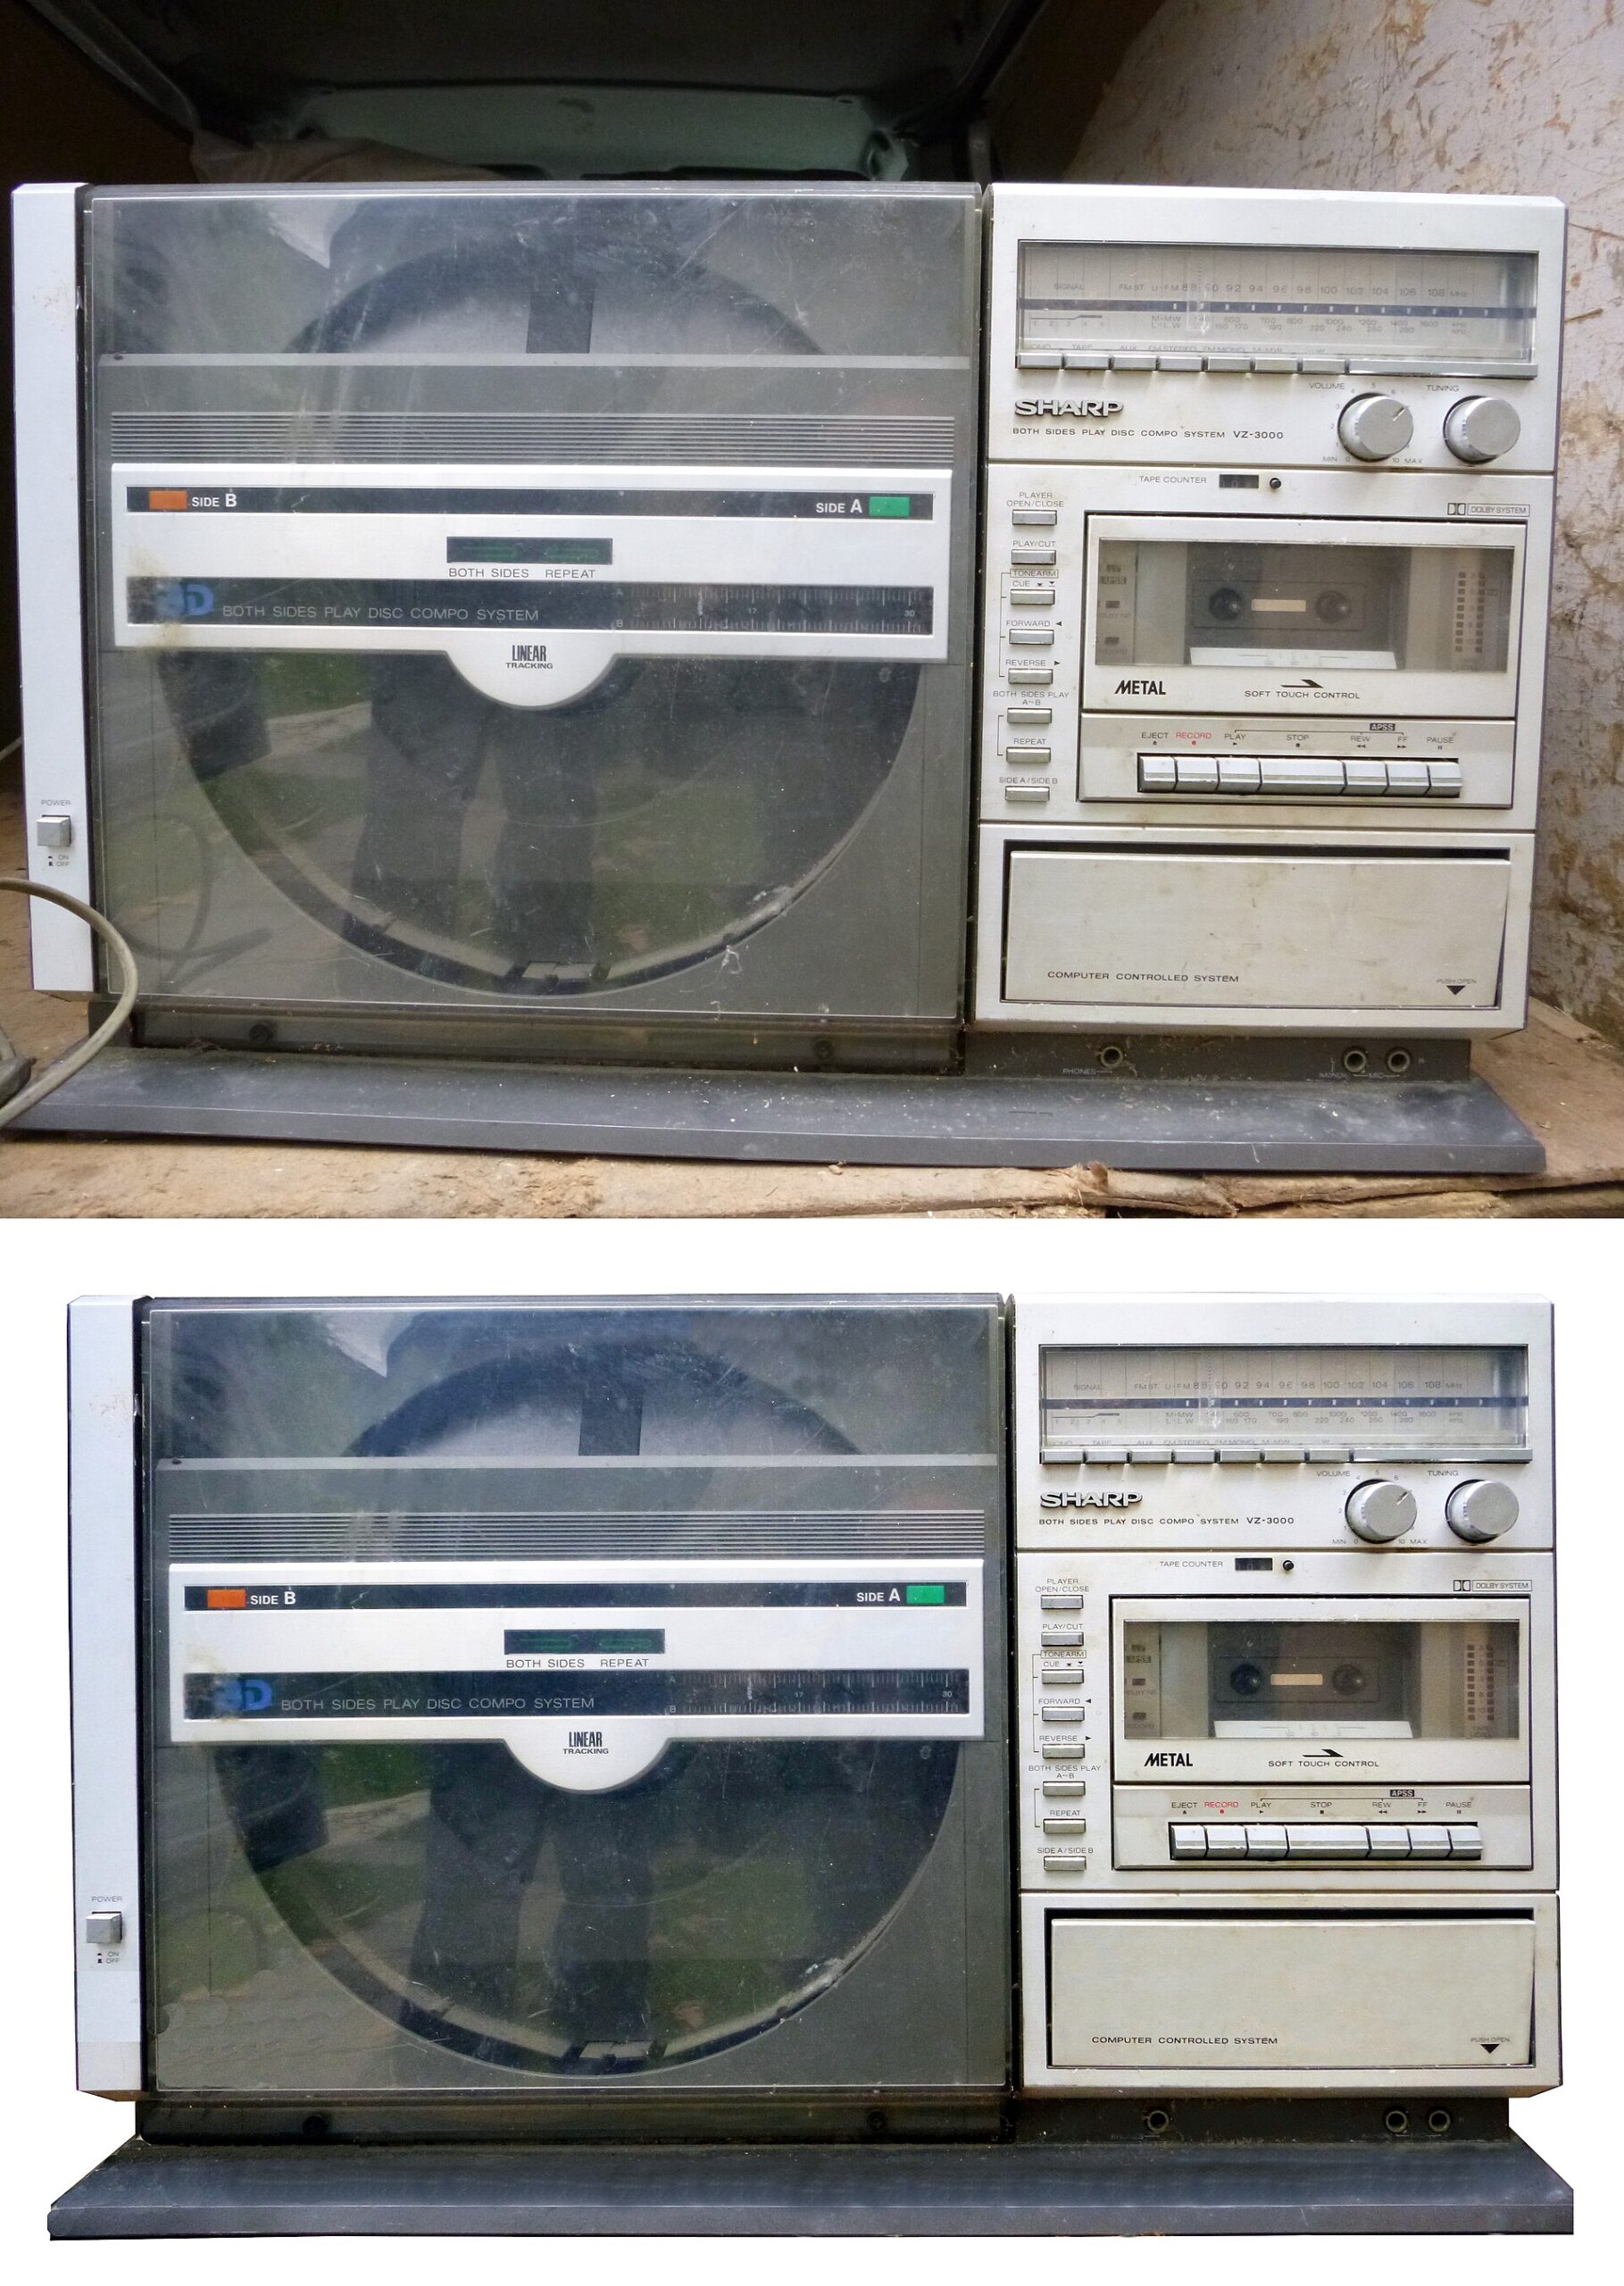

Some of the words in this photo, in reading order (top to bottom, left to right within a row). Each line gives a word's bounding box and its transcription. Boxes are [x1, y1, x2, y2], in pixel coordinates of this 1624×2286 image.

[1226, 284, 1241, 293] 92
[1249, 284, 1263, 293] 94
[1297, 286, 1312, 295] 98
[1320, 286, 1337, 295] 100
[1346, 287, 1363, 296] 102
[1372, 288, 1388, 296] 104
[1399, 288, 1417, 296] 106
[1428, 288, 1445, 297] 108
[1309, 381, 1346, 390] VOLUME
[1427, 384, 1460, 392] TUNING
[1013, 398, 1125, 419] SHARP
[1012, 427, 1040, 436] BOTH
[1045, 428, 1077, 436] SIDES
[1081, 429, 1106, 437] PLAY
[1111, 429, 1136, 438] DISC
[1140, 430, 1178, 438] COMPO
[1184, 430, 1226, 438] SYSTEM
[1233, 430, 1284, 440] VZ-3000
[1139, 475, 1162, 484] TAPE
[1163, 476, 1207, 484] COUNTER
[191, 496, 220, 508] SIDE
[225, 493, 237, 508] B
[1006, 500, 1064, 508] OPEN/CLOSE
[815, 502, 845, 513] SIDE
[849, 498, 862, 513] A
[1470, 505, 1495, 514] DOLBY
[1495, 505, 1527, 514] SYSTEM
[448, 568, 485, 578] BOTH
[490, 568, 529, 579] SIDES
[545, 569, 595, 579] REPEAT
[223, 605, 265, 617] BOTH
[273, 605, 317, 618] SIDES
[324, 606, 362, 618] PLAY
[368, 607, 403, 620] DISC
[410, 608, 469, 620] COMPO
[477, 609, 539, 622] SYSTEM
[904, 610, 915, 618] 30
[1005, 620, 1051, 628] FORWARD
[512, 645, 547, 662] LINEAR
[505, 662, 554, 670] TRACKING
[1005, 659, 1046, 667] REVERSE
[1114, 680, 1167, 696] METAL
[1020, 690, 1045, 698] SIDES
[1245, 690, 1270, 698] SOFT
[1276, 690, 1309, 699] TOUCH
[1313, 691, 1361, 699] CONTROL
[1370, 723, 1395, 731] APSS
[1141, 731, 1169, 739] EJECT
[1176, 731, 1212, 739] RECORD
[1286, 734, 1310, 742] STOP
[1013, 738, 1046, 746] REPEAT
[1427, 736, 1454, 744] PAUSE
[1047, 971, 1110, 980] COMPUTER
[1115, 972, 1189, 982] CONTROLLED
[1194, 974, 1239, 983] SYSTEM
[1235, 1381, 1249, 1389] 92
[1256, 1381, 1270, 1389] 94
[1302, 1381, 1315, 1389] 98
[1323, 1381, 1339, 1389] 100
[1348, 1381, 1364, 1389] 102
[1372, 1381, 1388, 1389] 104
[1398, 1381, 1414, 1389] 106
[1425, 1381, 1441, 1389] 108
[1040, 1491, 1143, 1509] SHARP
[1245, 1517, 1295, 1525] VZ-3000
[250, 1595, 279, 1605] SIDE
[284, 1591, 296, 1605] B
[856, 1592, 885, 1603] SIDE
[888, 1588, 901, 1602] A
[506, 1659, 541, 1669] BOTH
[547, 1658, 585, 1668] SIDES
[600, 1658, 649, 1668] REPEAT
[281, 1699, 324, 1711] BOTH
[332, 1698, 376, 1710] SIDES
[383, 1698, 421, 1710] PLAY
[427, 1698, 462, 1709] DISC
[469, 1698, 526, 1709] COMPO
[534, 1698, 595, 1709] SYSTEM
[569, 1731, 603, 1748] LINEAR
[1144, 1753, 1194, 1767] METAL
[1251, 1801, 1272, 1809] PLAY
[1310, 1801, 1333, 1809] STOP
[1092, 2036, 1152, 2044] COMPUTER
[1158, 2037, 1229, 2045] CONTROLLED
[1234, 2037, 1278, 2045] SYSTEM
